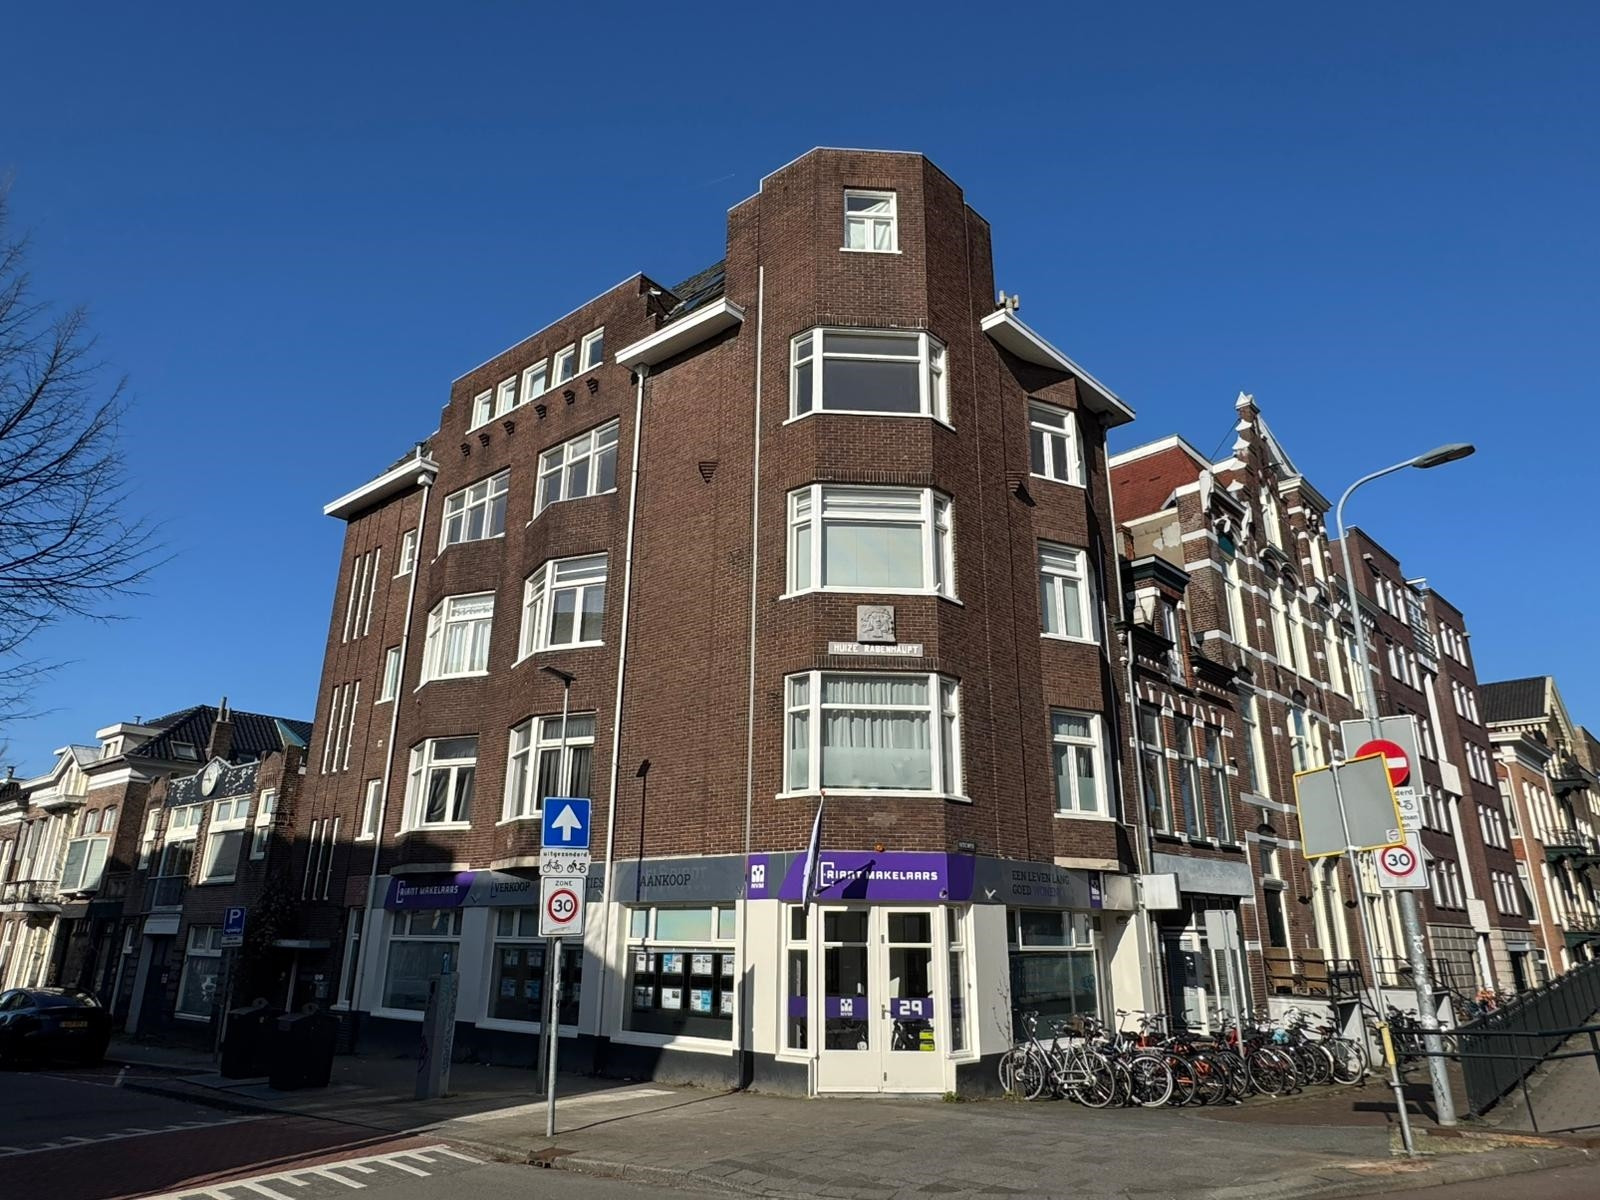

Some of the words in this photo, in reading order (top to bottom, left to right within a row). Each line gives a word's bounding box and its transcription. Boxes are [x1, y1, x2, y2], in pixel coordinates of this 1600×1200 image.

[833, 644, 858, 653] HUIZE
[864, 645, 919, 654] RABENHAUPT
[1387, 853, 1411, 866] 30
[640, 873, 691, 887] AANKOOP
[865, 870, 938, 881] MAKELAARS
[1011, 870, 1027, 881] EEN
[1028, 871, 1051, 883] LEVEN
[420, 885, 460, 895] MAKELAARS
[495, 881, 530, 892] VERKOOP
[1012, 884, 1032, 895] GOED
[553, 899, 574, 913] 30
[229, 909, 242, 924] P
[899, 1000, 923, 1015] 29
